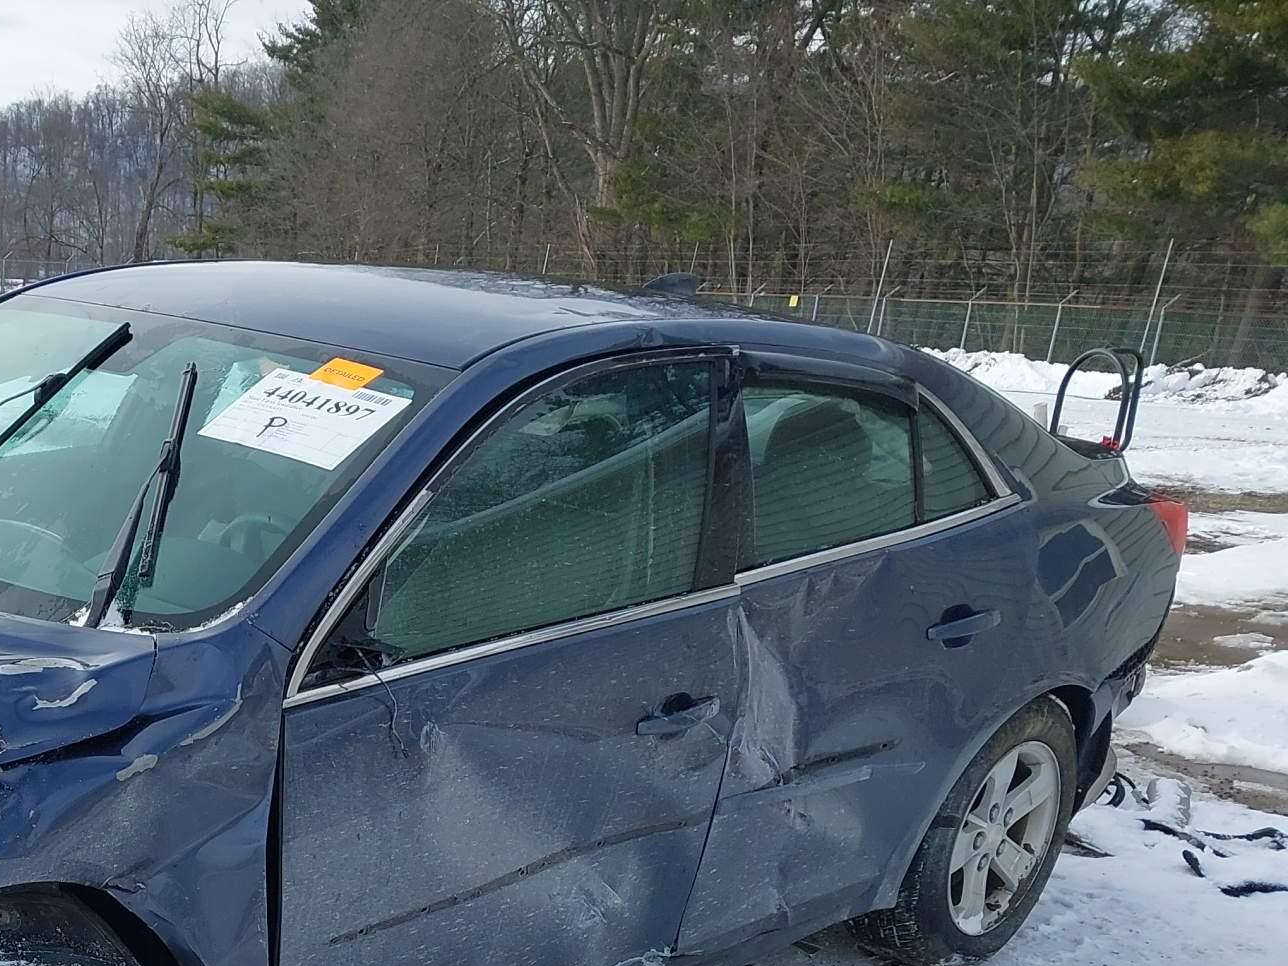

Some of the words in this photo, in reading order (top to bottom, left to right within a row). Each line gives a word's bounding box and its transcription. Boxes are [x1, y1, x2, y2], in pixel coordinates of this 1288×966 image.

[323, 367, 366, 382] DETAILED
[263, 386, 376, 421] 44041897
[256, 416, 288, 438] P
